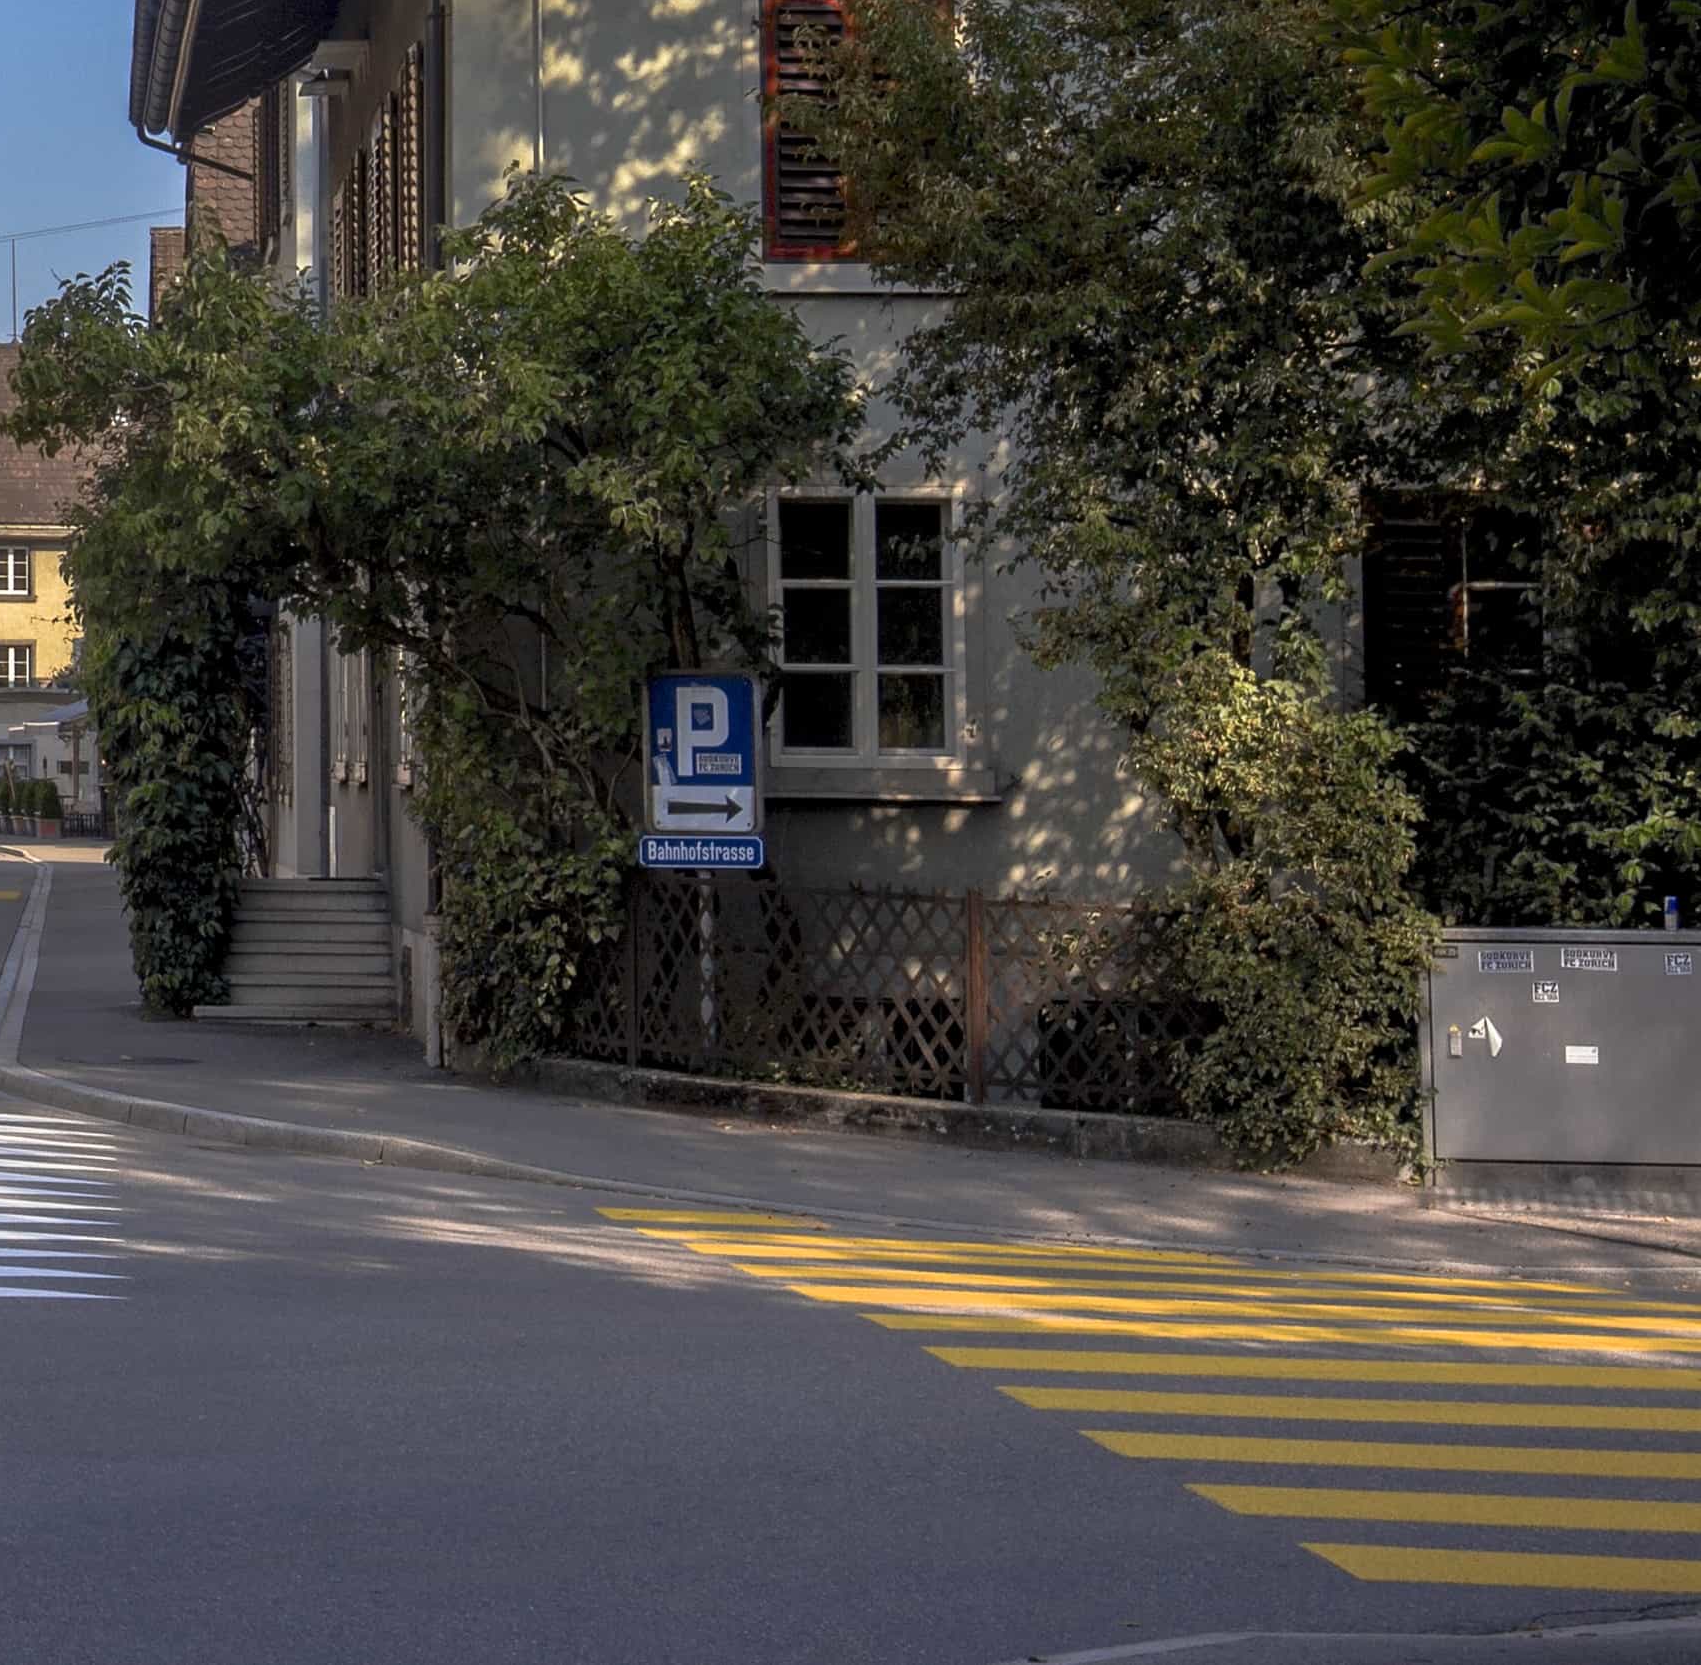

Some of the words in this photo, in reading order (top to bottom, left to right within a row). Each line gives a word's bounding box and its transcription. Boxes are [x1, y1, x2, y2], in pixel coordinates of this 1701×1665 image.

[676, 686, 729, 776] P
[647, 840, 755, 862] Bahnhofstrasse
[1667, 954, 1690, 966] FCZ
[1534, 982, 1557, 993] FCZ
